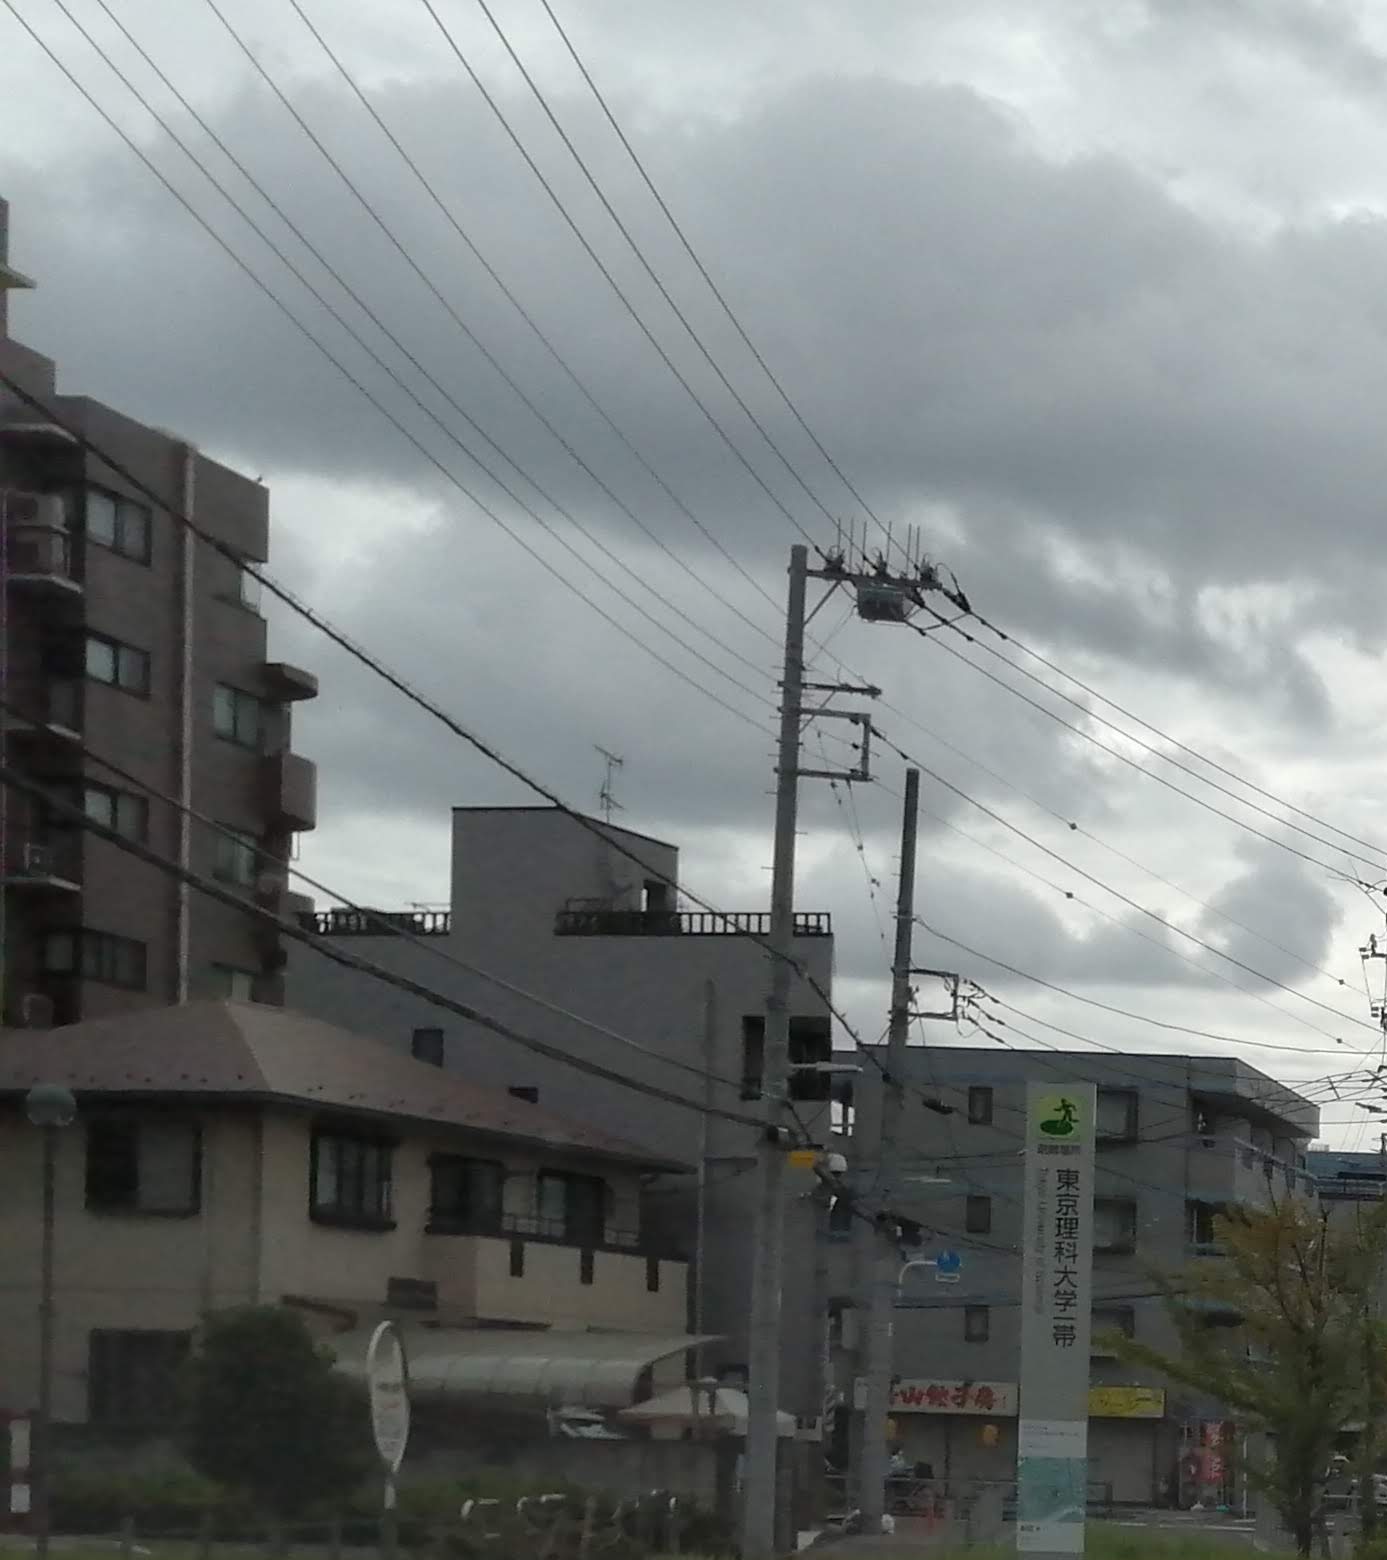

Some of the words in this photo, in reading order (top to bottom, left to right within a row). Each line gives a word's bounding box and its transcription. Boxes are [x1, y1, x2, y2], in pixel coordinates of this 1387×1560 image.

[1053, 1168, 1080, 1348] 東京理科大学一帯
